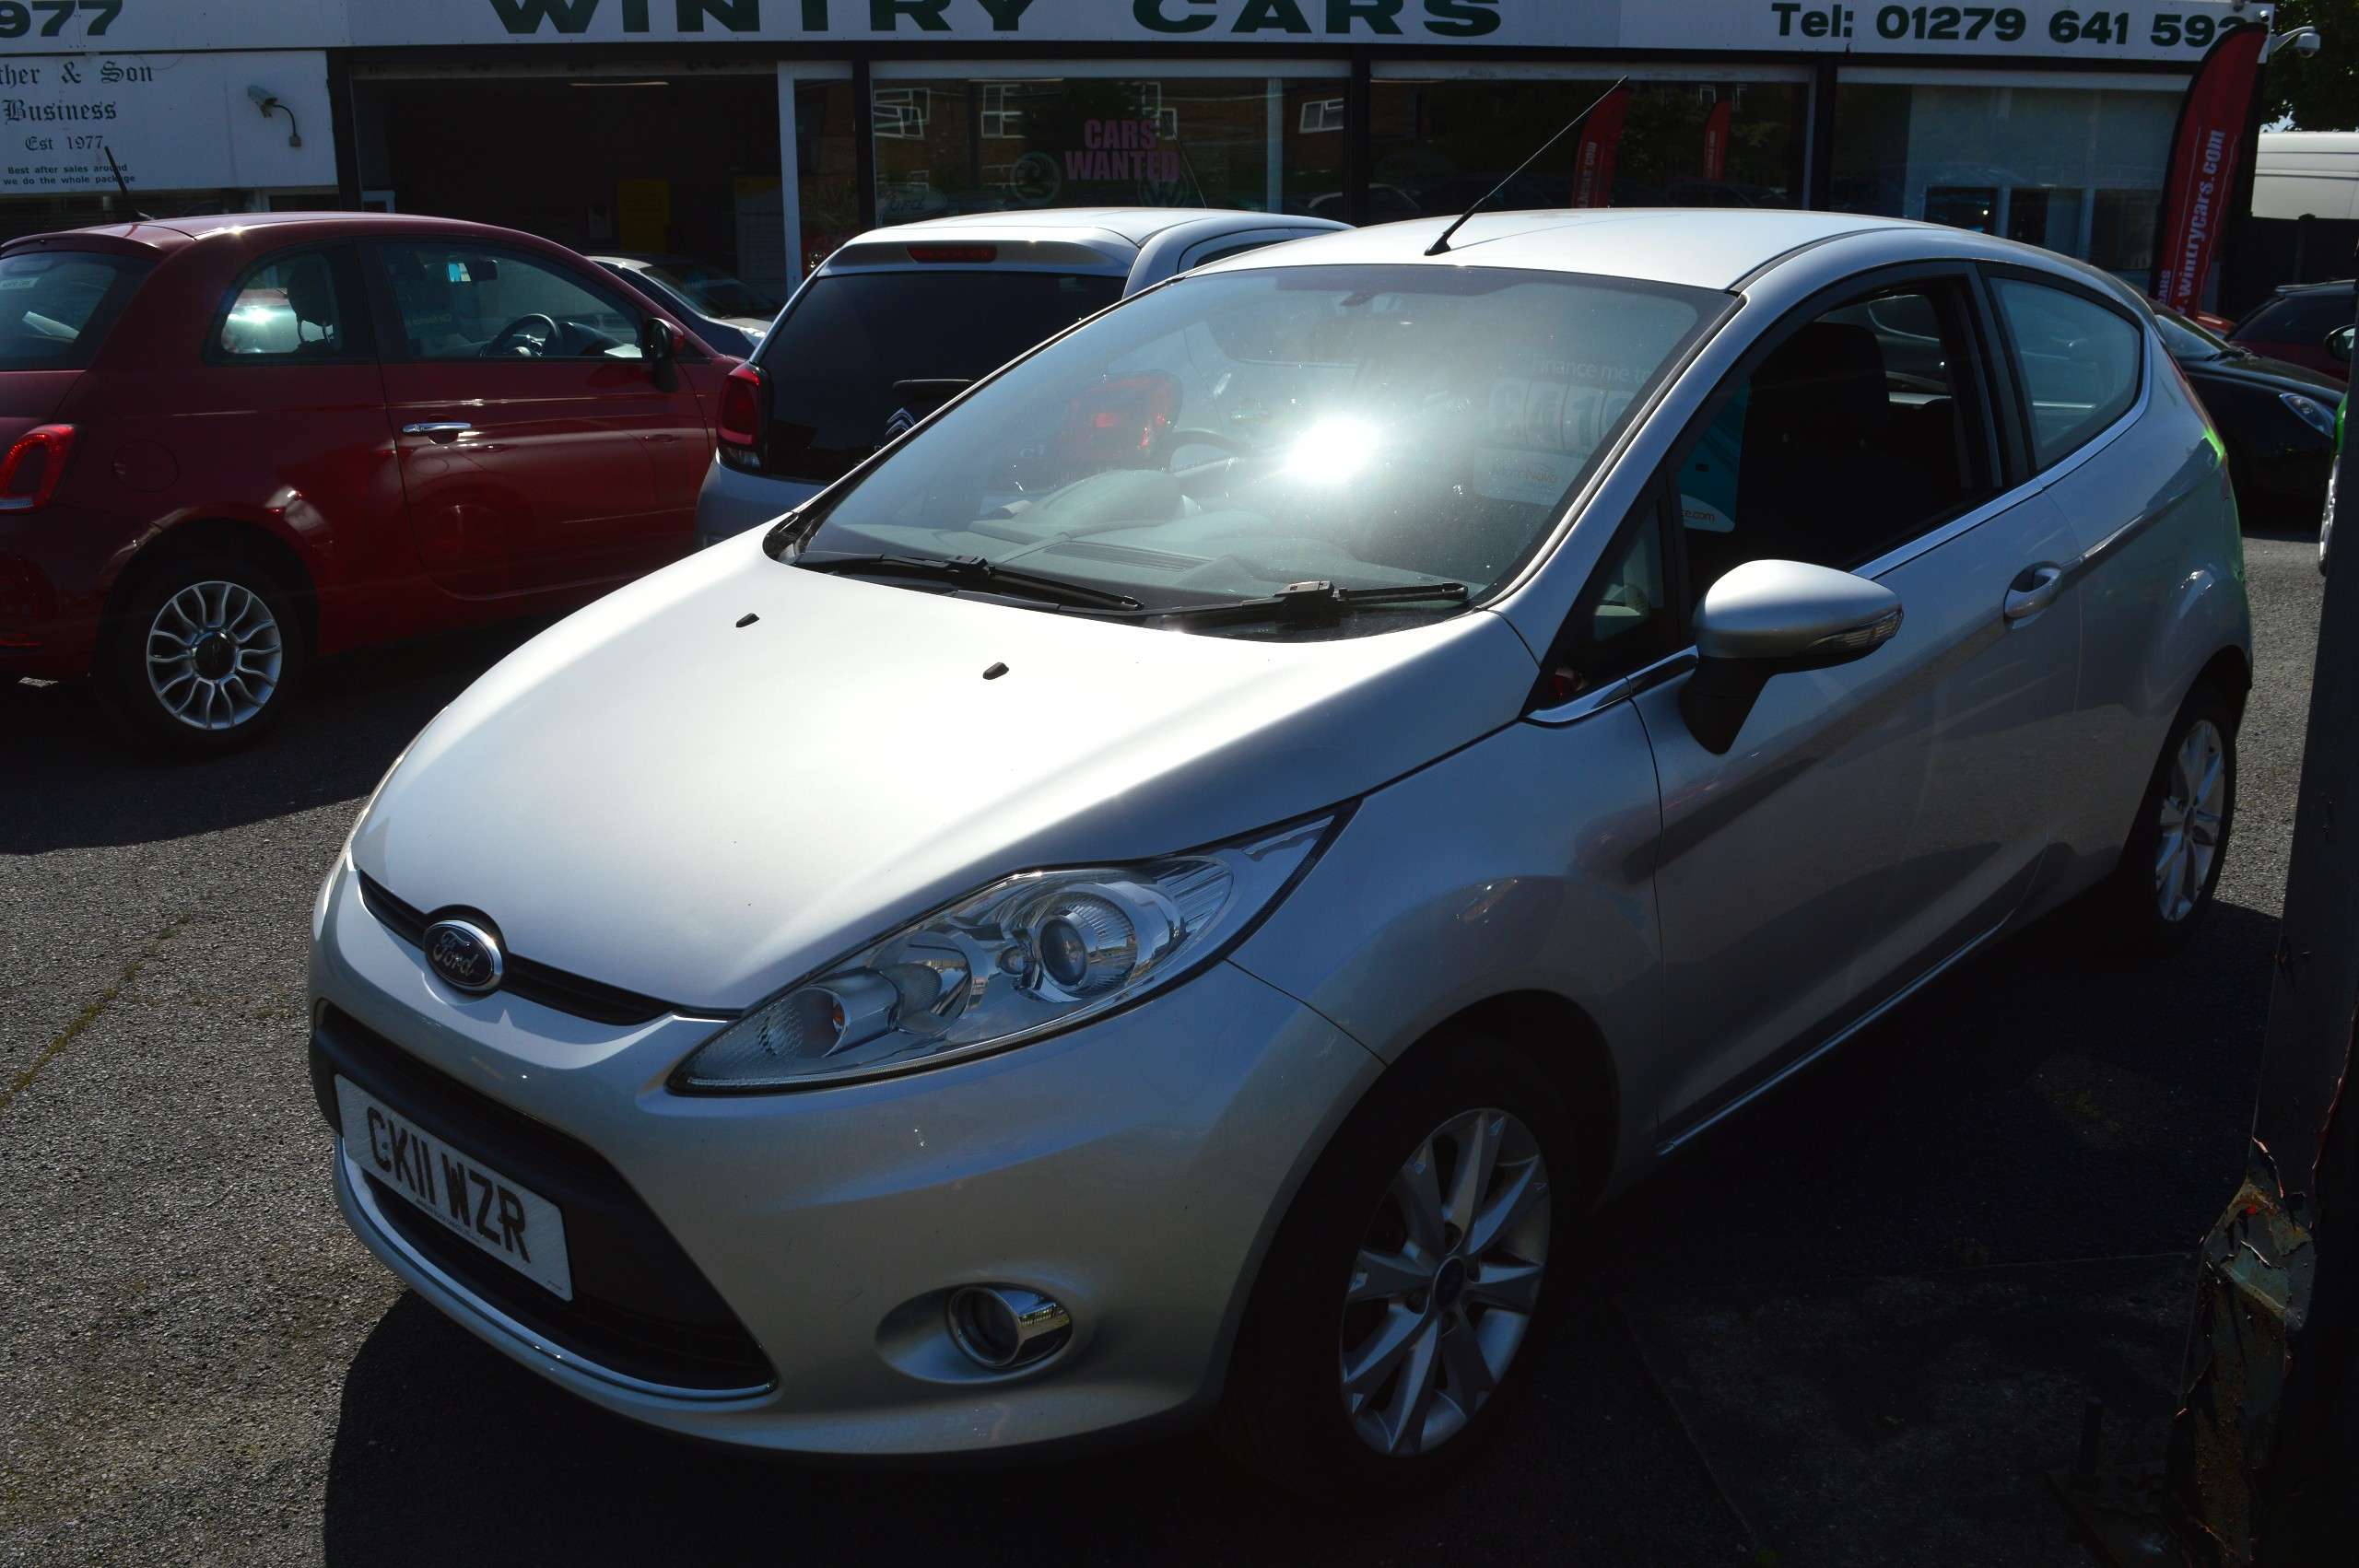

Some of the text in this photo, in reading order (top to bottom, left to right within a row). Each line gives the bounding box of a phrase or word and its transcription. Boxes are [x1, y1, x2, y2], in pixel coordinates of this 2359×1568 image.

[0, 0, 123, 38] 977
[1133, 0, 1502, 37] CARS
[1771, 3, 1853, 38] Tel:
[1876, 4, 2026, 42] 01279
[2048, 10, 2129, 45] 641
[61, 61, 82, 84] &
[100, 61, 153, 84] Son
[3, 99, 118, 124] Business
[25, 135, 104, 151] Est 1977
[1085, 119, 1157, 149] CARS
[4, 174, 135, 185] we do the whole packge
[7, 166, 30, 175] Best
[35, 165, 58, 174] after
[64, 165, 89, 173] sales
[1064, 149, 1180, 183] WANTED
[433, 930, 482, 978] Ford
[441, 1151, 532, 1264] WZR
